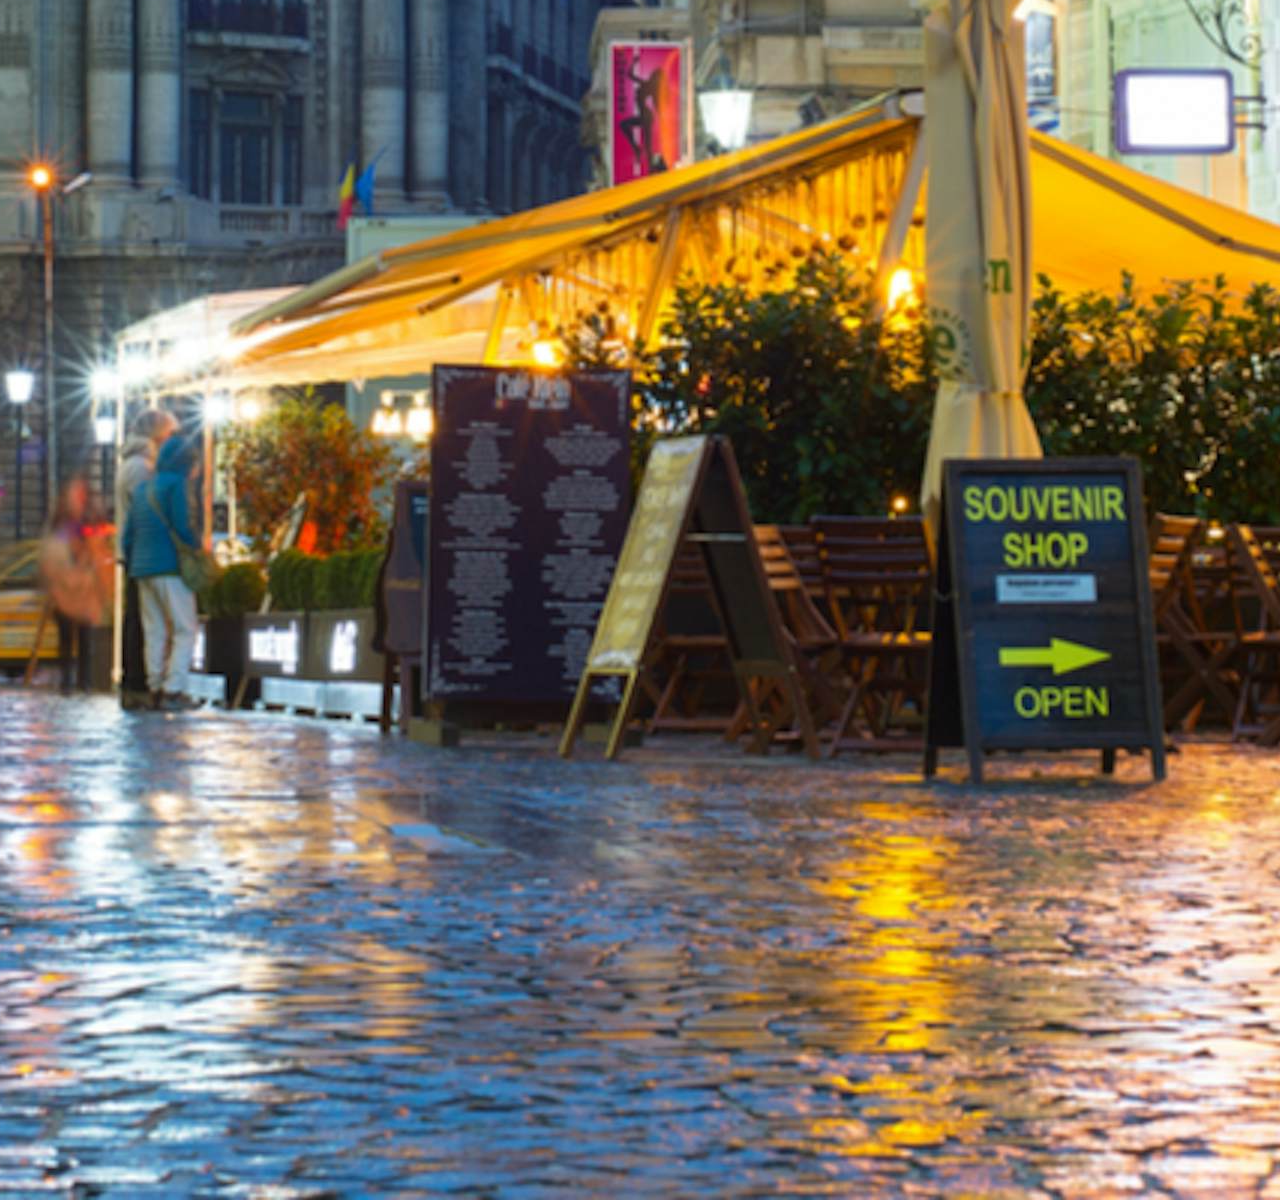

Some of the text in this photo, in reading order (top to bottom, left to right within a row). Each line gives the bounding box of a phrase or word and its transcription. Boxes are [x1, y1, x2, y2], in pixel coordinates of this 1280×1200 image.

[963, 485, 1126, 522] SOUVENIR
[1003, 532, 1089, 568] SHOP
[1014, 686, 1110, 718] OPEN
